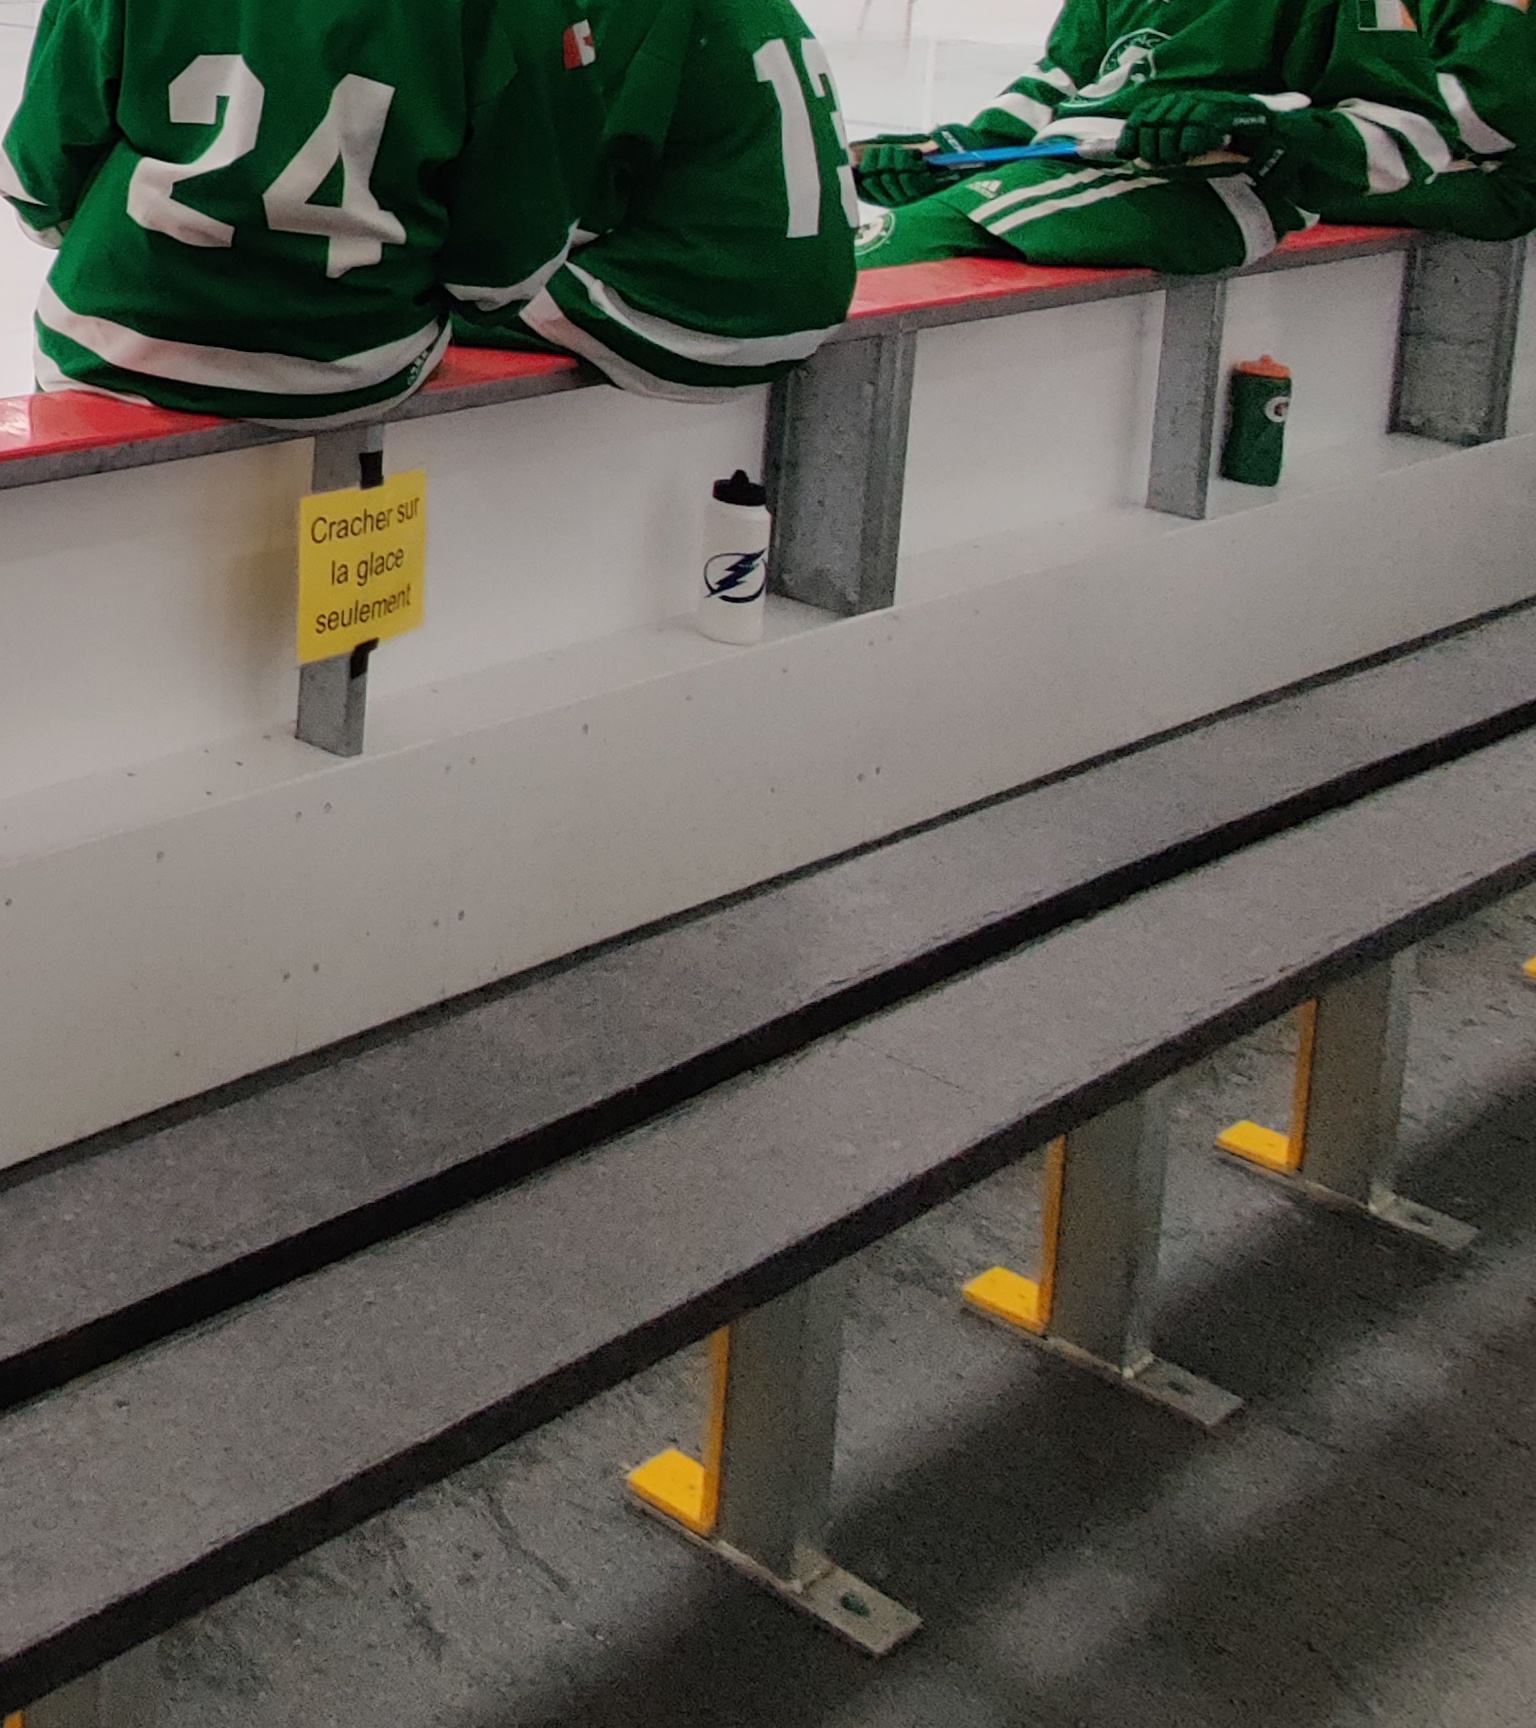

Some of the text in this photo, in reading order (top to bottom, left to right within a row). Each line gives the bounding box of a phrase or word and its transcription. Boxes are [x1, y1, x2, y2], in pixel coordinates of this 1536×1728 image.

[126, 53, 407, 279] 24
[310, 497, 421, 545] Cracher sur
[330, 548, 405, 587] la glace
[315, 583, 412, 634] seulement
